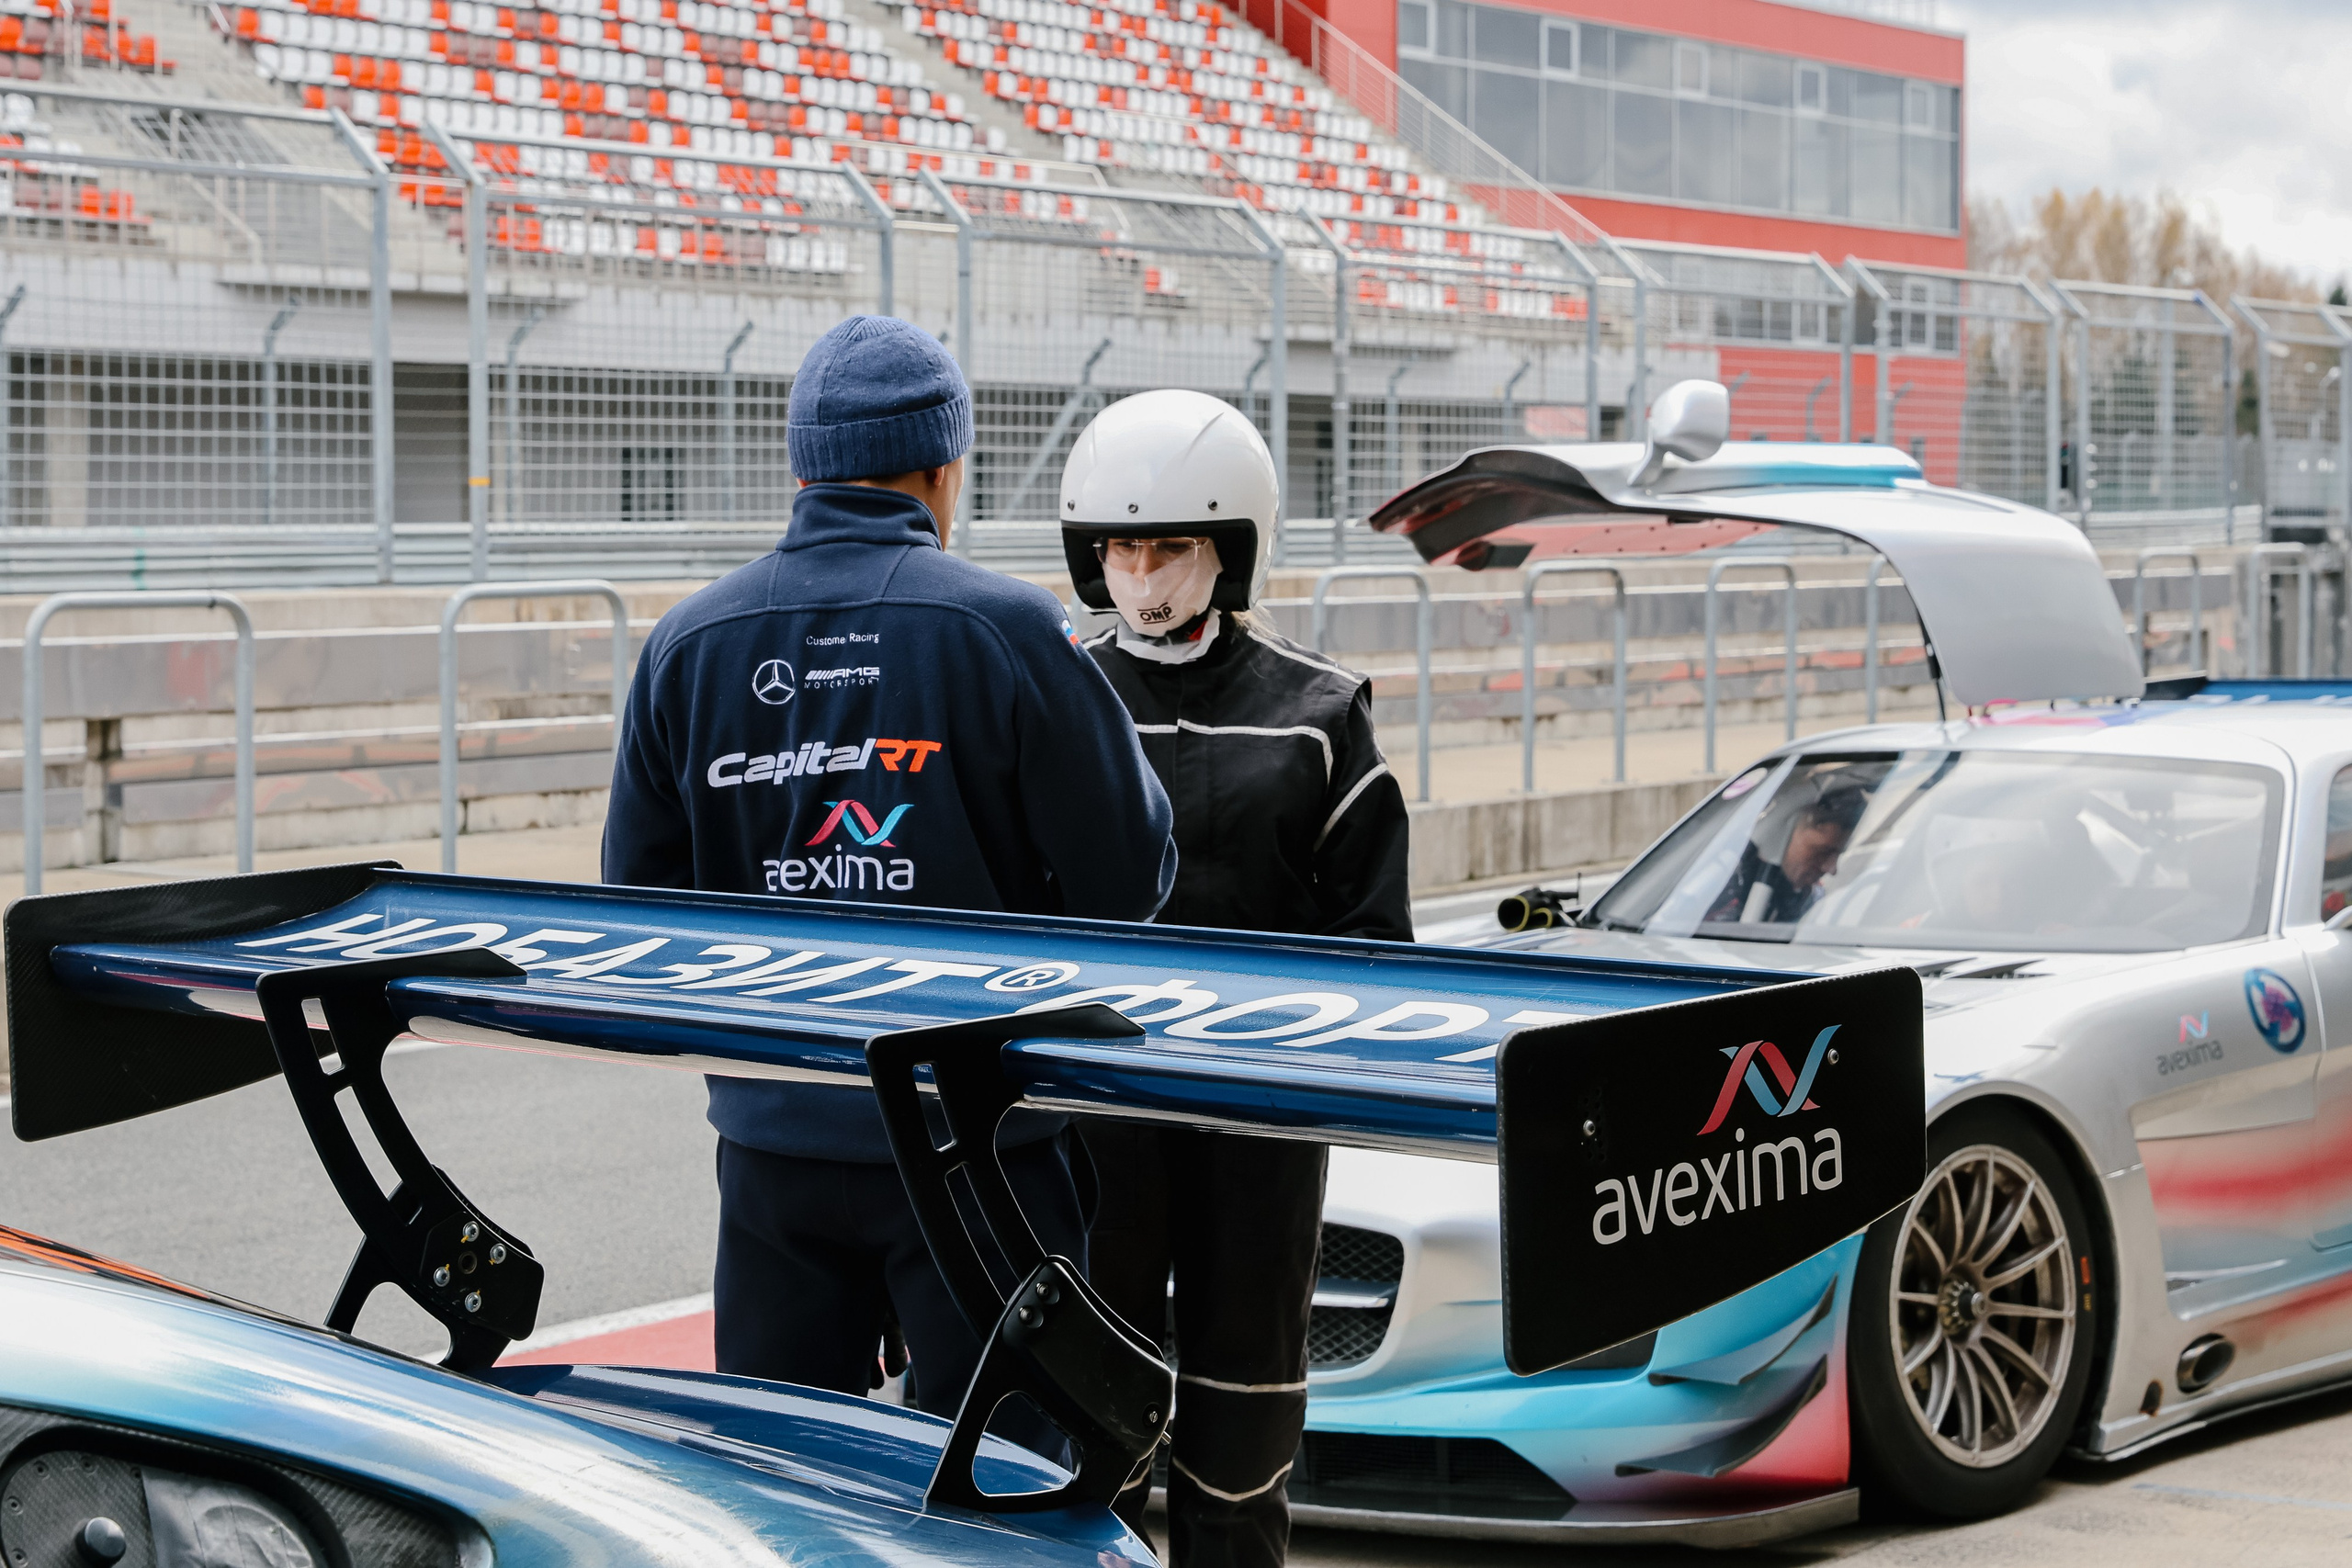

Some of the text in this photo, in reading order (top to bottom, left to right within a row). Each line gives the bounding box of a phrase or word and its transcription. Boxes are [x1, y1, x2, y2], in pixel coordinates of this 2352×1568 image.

[1139, 606, 1172, 621] OMP
[806, 633, 879, 645] Custome Racing
[1592, 1128, 1843, 1245] avexima
